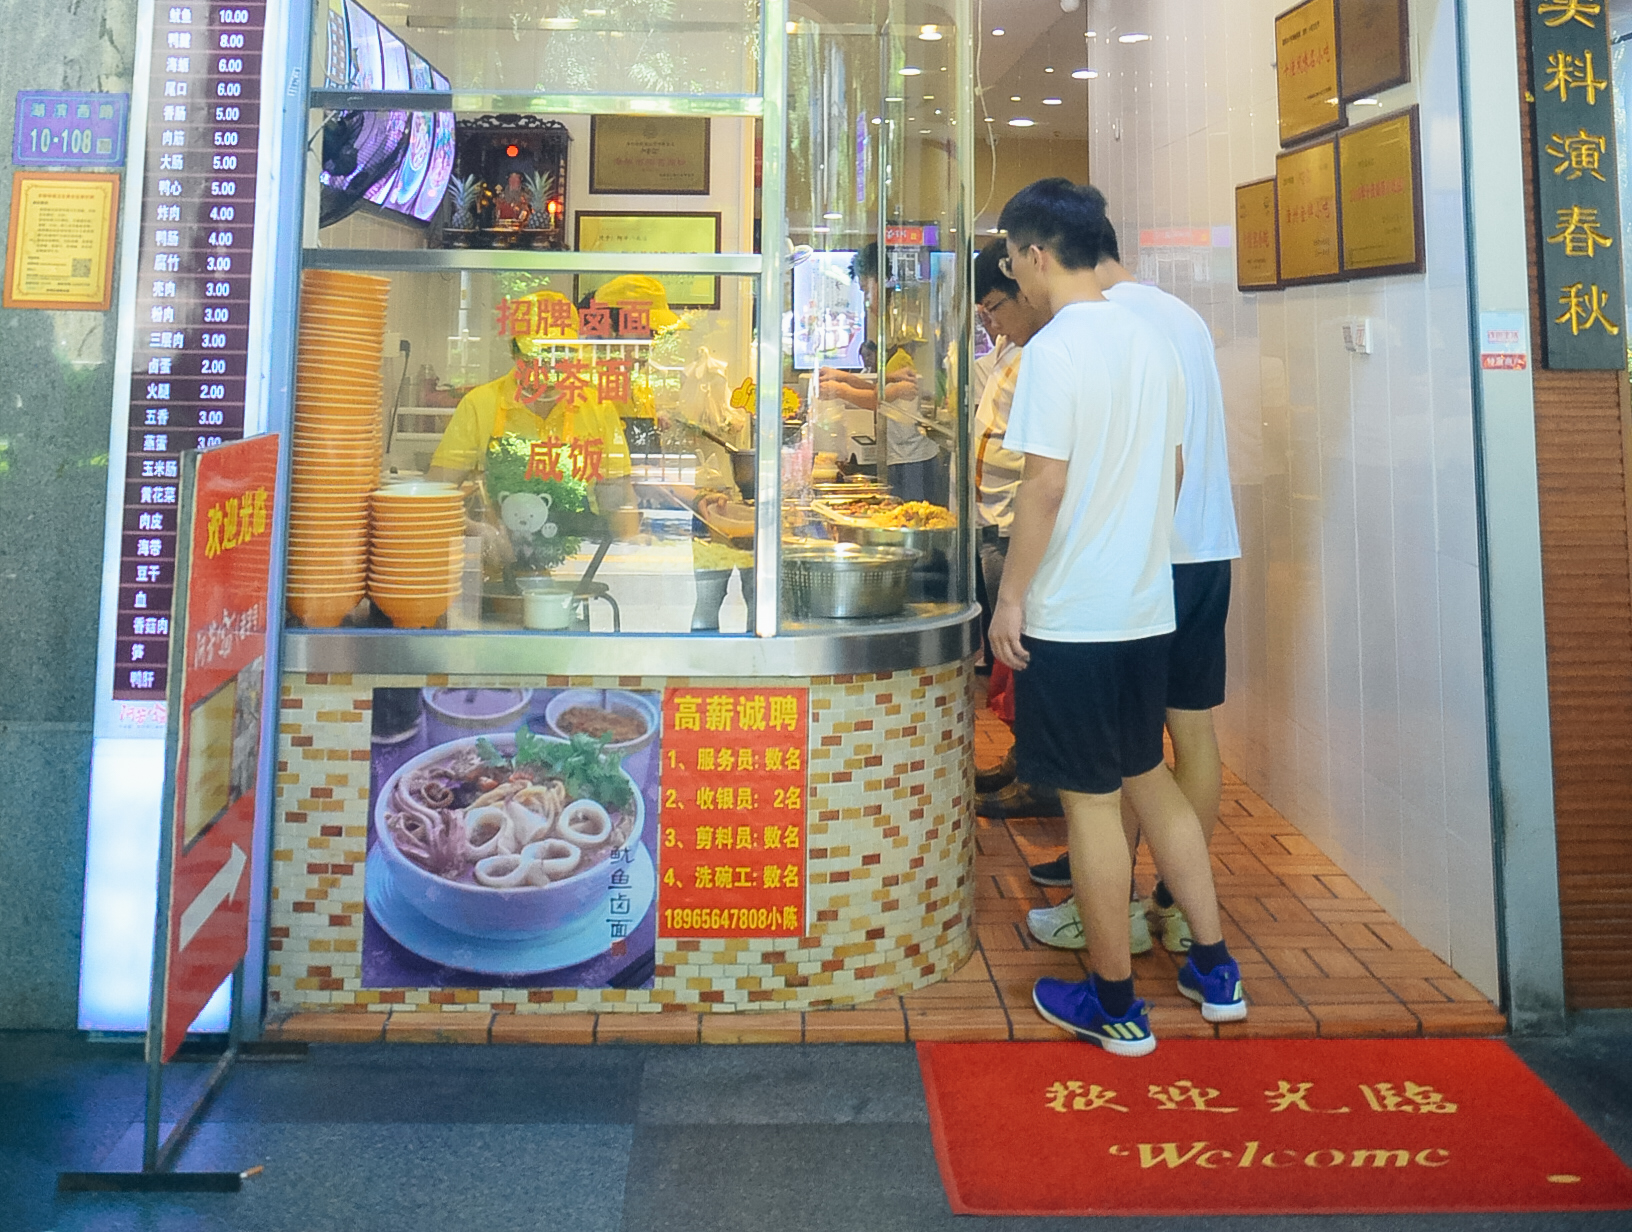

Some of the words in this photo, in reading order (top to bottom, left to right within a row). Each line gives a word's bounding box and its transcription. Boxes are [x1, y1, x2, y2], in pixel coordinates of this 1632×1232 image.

[219, 9, 249, 23] 10.00
[219, 34, 244, 48] 8.00
[218, 58, 243, 72] 6.00
[217, 83, 241, 97] 6.00
[215, 107, 240, 121] 5.00
[214, 132, 238, 146] 5.00
[160, 154, 184, 170] 大肠
[212, 156, 237, 170] 5.00
[158, 179, 182, 196] 鸭心
[211, 181, 236, 195] 5.00
[209, 206, 235, 221] 4.00
[208, 231, 233, 246] 4.00
[153, 253, 180, 272] 腐竹
[206, 256, 231, 271] 3.00
[205, 282, 230, 297] 3.00
[204, 307, 229, 322] 3.00
[495, 298, 654, 337] 招牌卤面
[148, 331, 184, 348] 三层肉
[201, 333, 226, 348] 3.00
[148, 356, 172, 374] 卤蛋
[201, 359, 226, 374] 2.00
[514, 358, 632, 404] 沙茶面
[199, 384, 225, 399] 2.00
[144, 408, 169, 425] 五香
[198, 410, 223, 425] 3.00
[141, 459, 178, 477] 玉米肠
[524, 436, 605, 483] 咸饭
[140, 486, 176, 504] 黄花菜
[138, 512, 163, 530] 肉皮
[205, 486, 268, 560] 欢迎光临
[137, 538, 162, 556] 海带
[135, 564, 160, 582] 豆干
[134, 590, 147, 608] 血
[133, 616, 169, 634] 香菇肉
[673, 694, 799, 732] 高薪诚聘
[606, 845, 634, 939] 鱿鱼卤面
[664, 905, 798, 931] 18965647808小陈
[1108, 1141, 1450, 1169] Welcome
